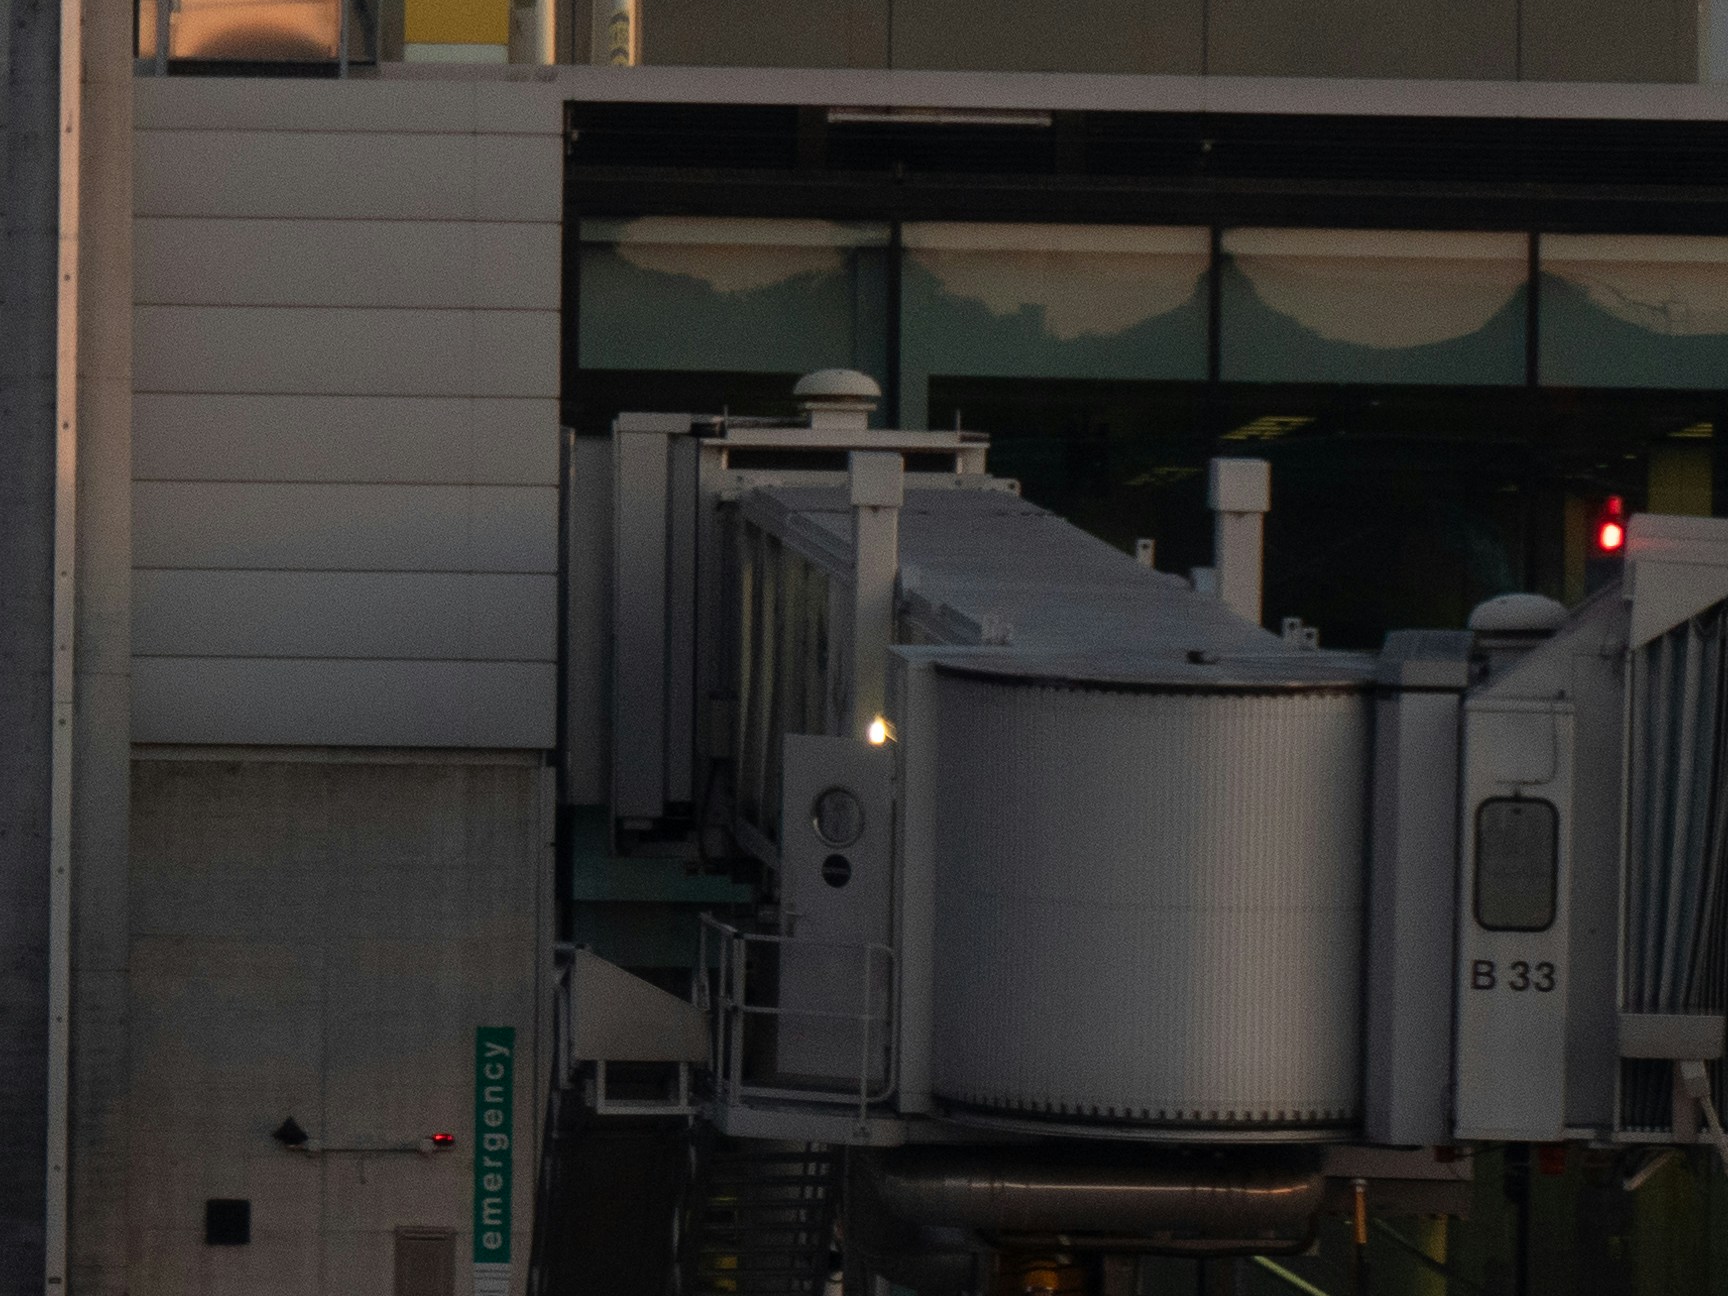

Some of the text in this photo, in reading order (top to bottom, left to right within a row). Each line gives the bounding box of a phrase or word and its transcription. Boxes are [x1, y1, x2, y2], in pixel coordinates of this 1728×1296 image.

[1471, 960, 1557, 992] B 33
[481, 1041, 511, 1251] emergency
